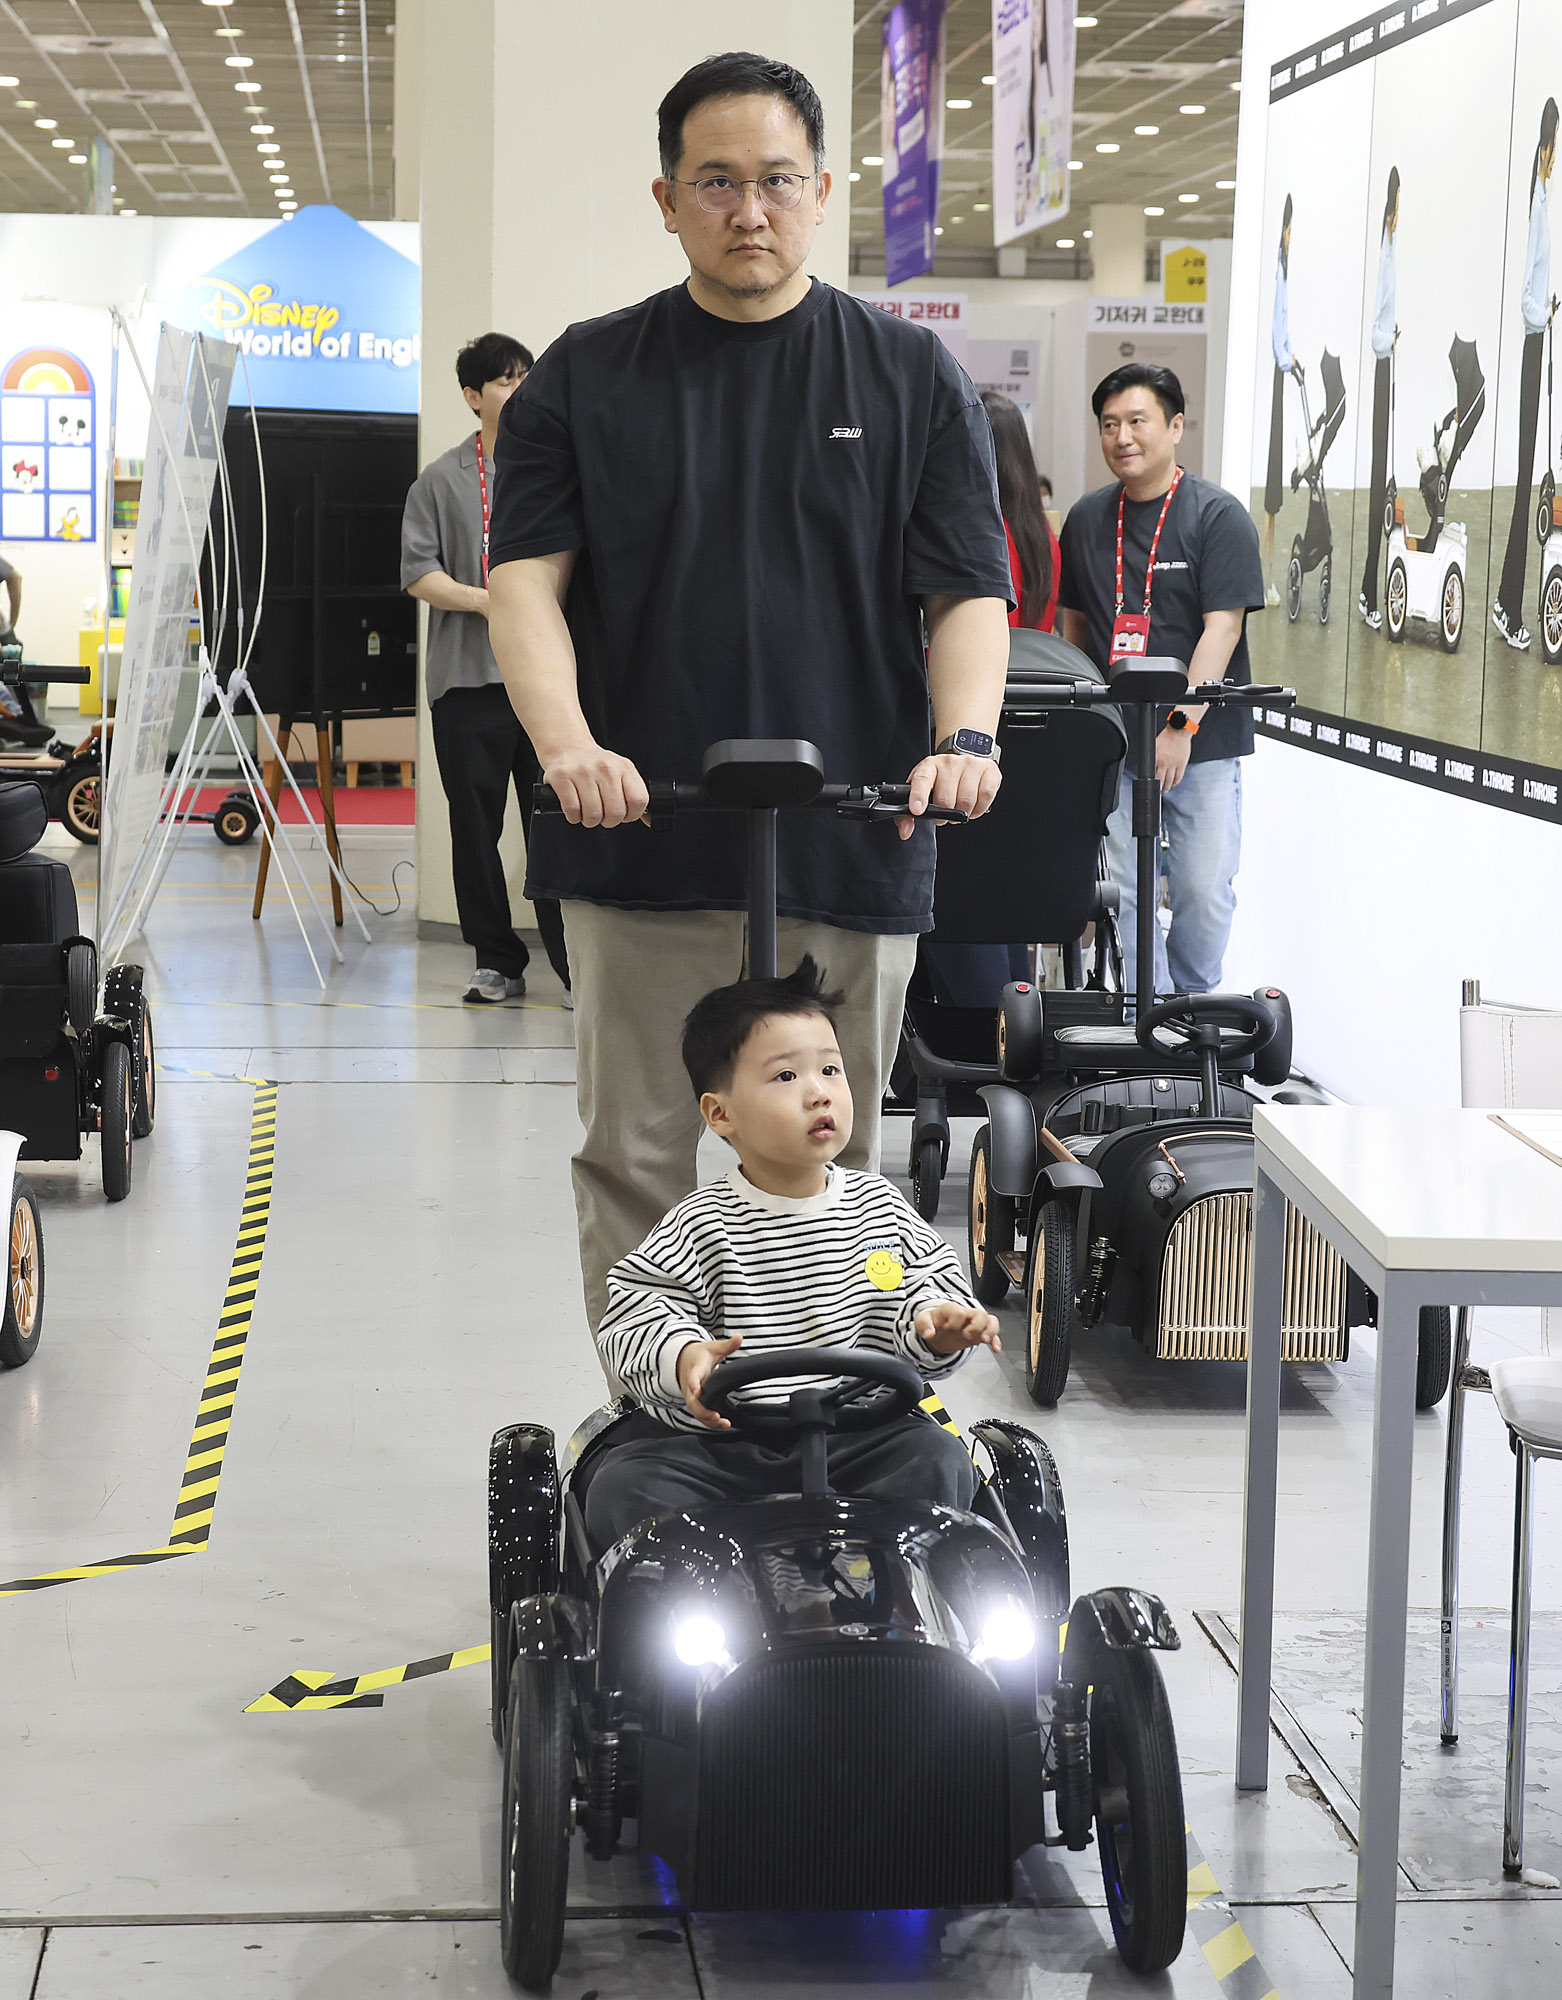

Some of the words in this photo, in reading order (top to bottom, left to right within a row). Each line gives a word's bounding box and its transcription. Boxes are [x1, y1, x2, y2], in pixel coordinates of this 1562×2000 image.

[1095, 305, 1147, 323] 기저귀
[1153, 305, 1205, 324] 교환대
[224, 328, 312, 357] World
[320, 332, 351, 358] of
[1444, 758, 1475, 783] D.THRONE
[1482, 768, 1515, 794] D.THRONE
[1522, 778, 1558, 805] D.THRONE
